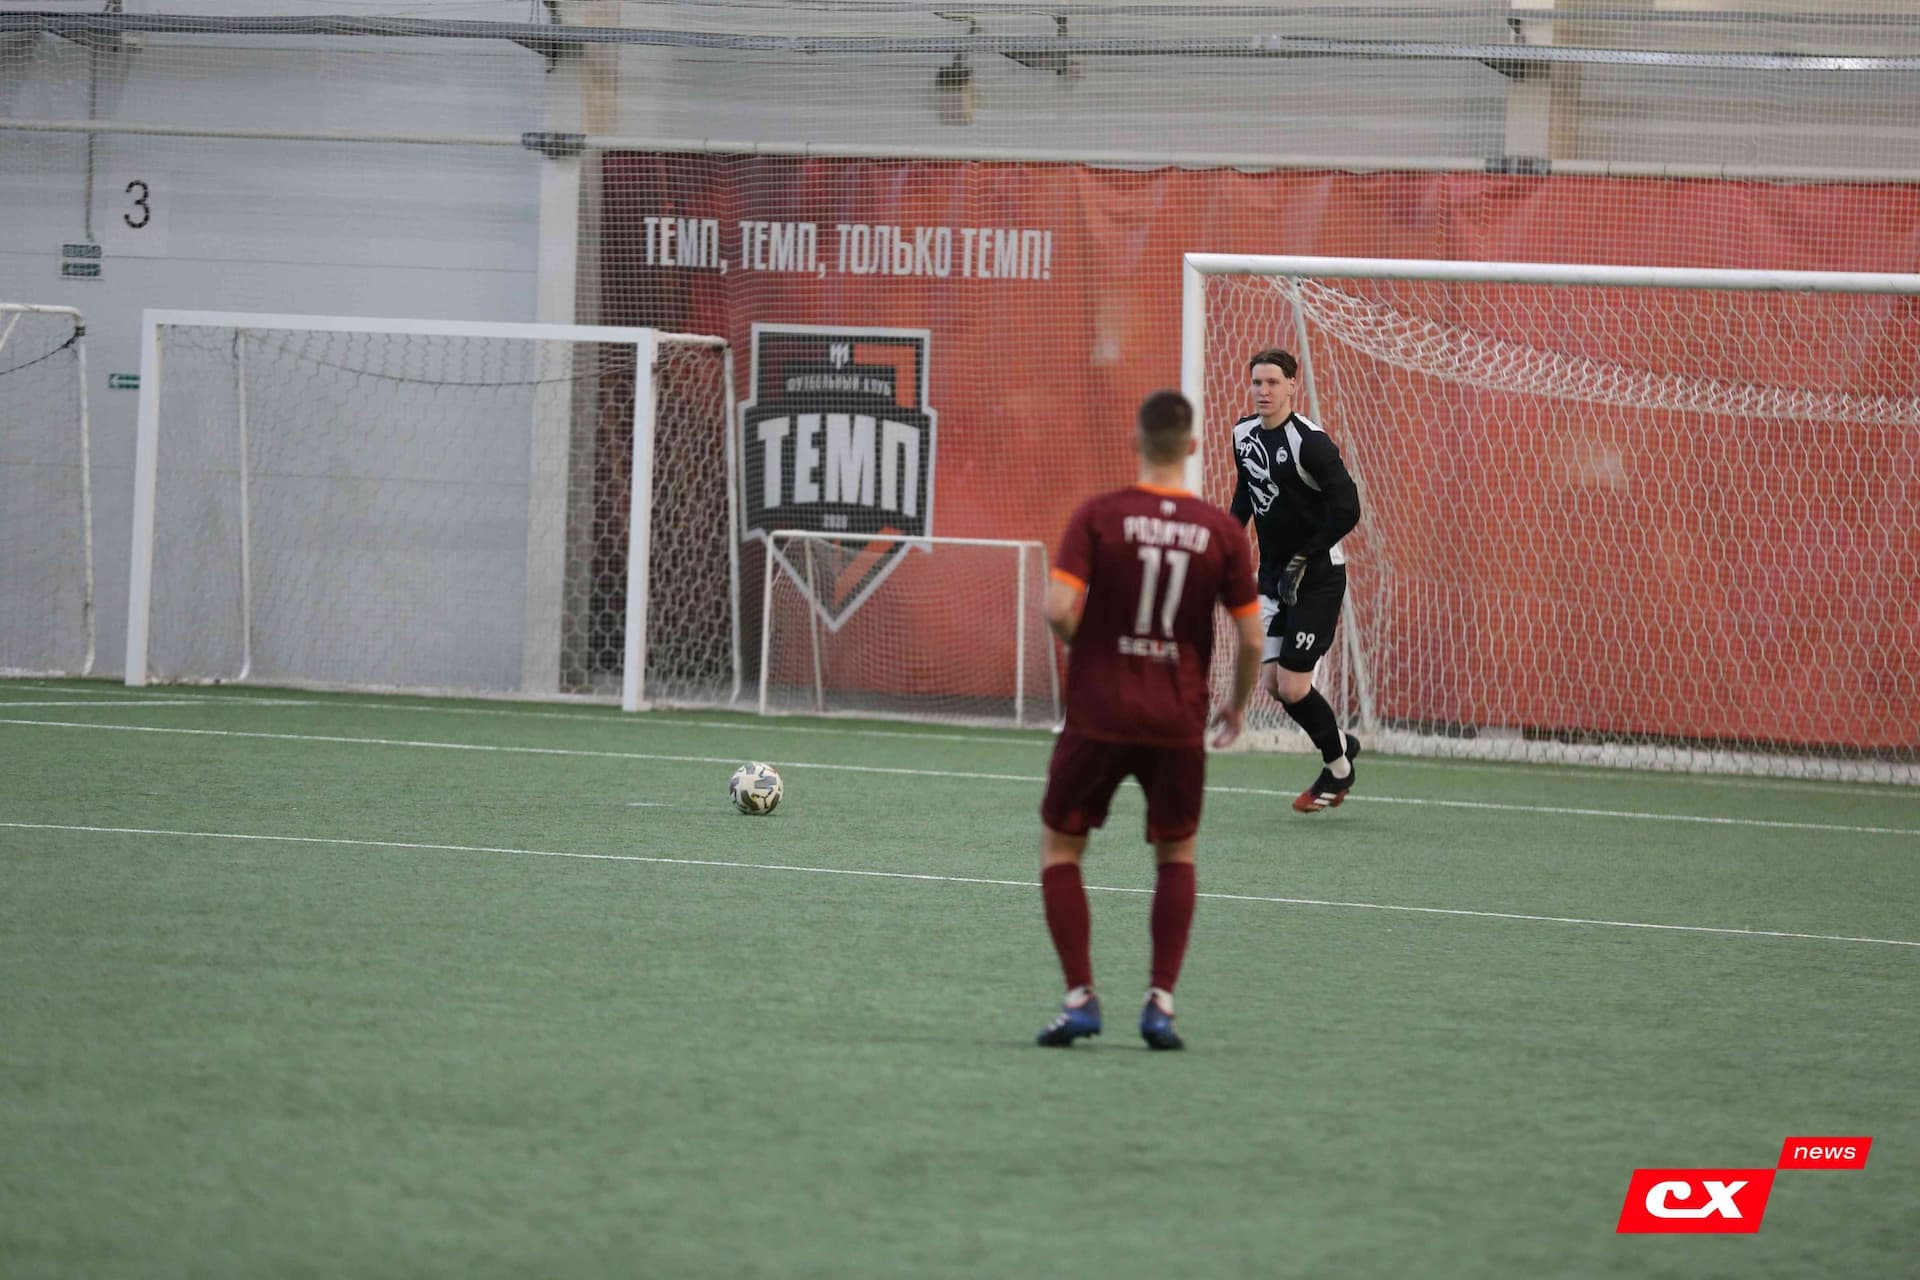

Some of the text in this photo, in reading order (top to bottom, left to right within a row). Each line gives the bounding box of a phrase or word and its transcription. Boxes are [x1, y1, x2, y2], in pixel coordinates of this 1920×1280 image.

[124, 180, 150, 229] 3
[644, 216, 1052, 280] ТЕМП, ТЕМП, ТОЛЬКО ТЕМП!
[757, 413, 920, 518] ТЕМП
[1135, 546, 1191, 638] 11
[1295, 631, 1315, 651] 99
